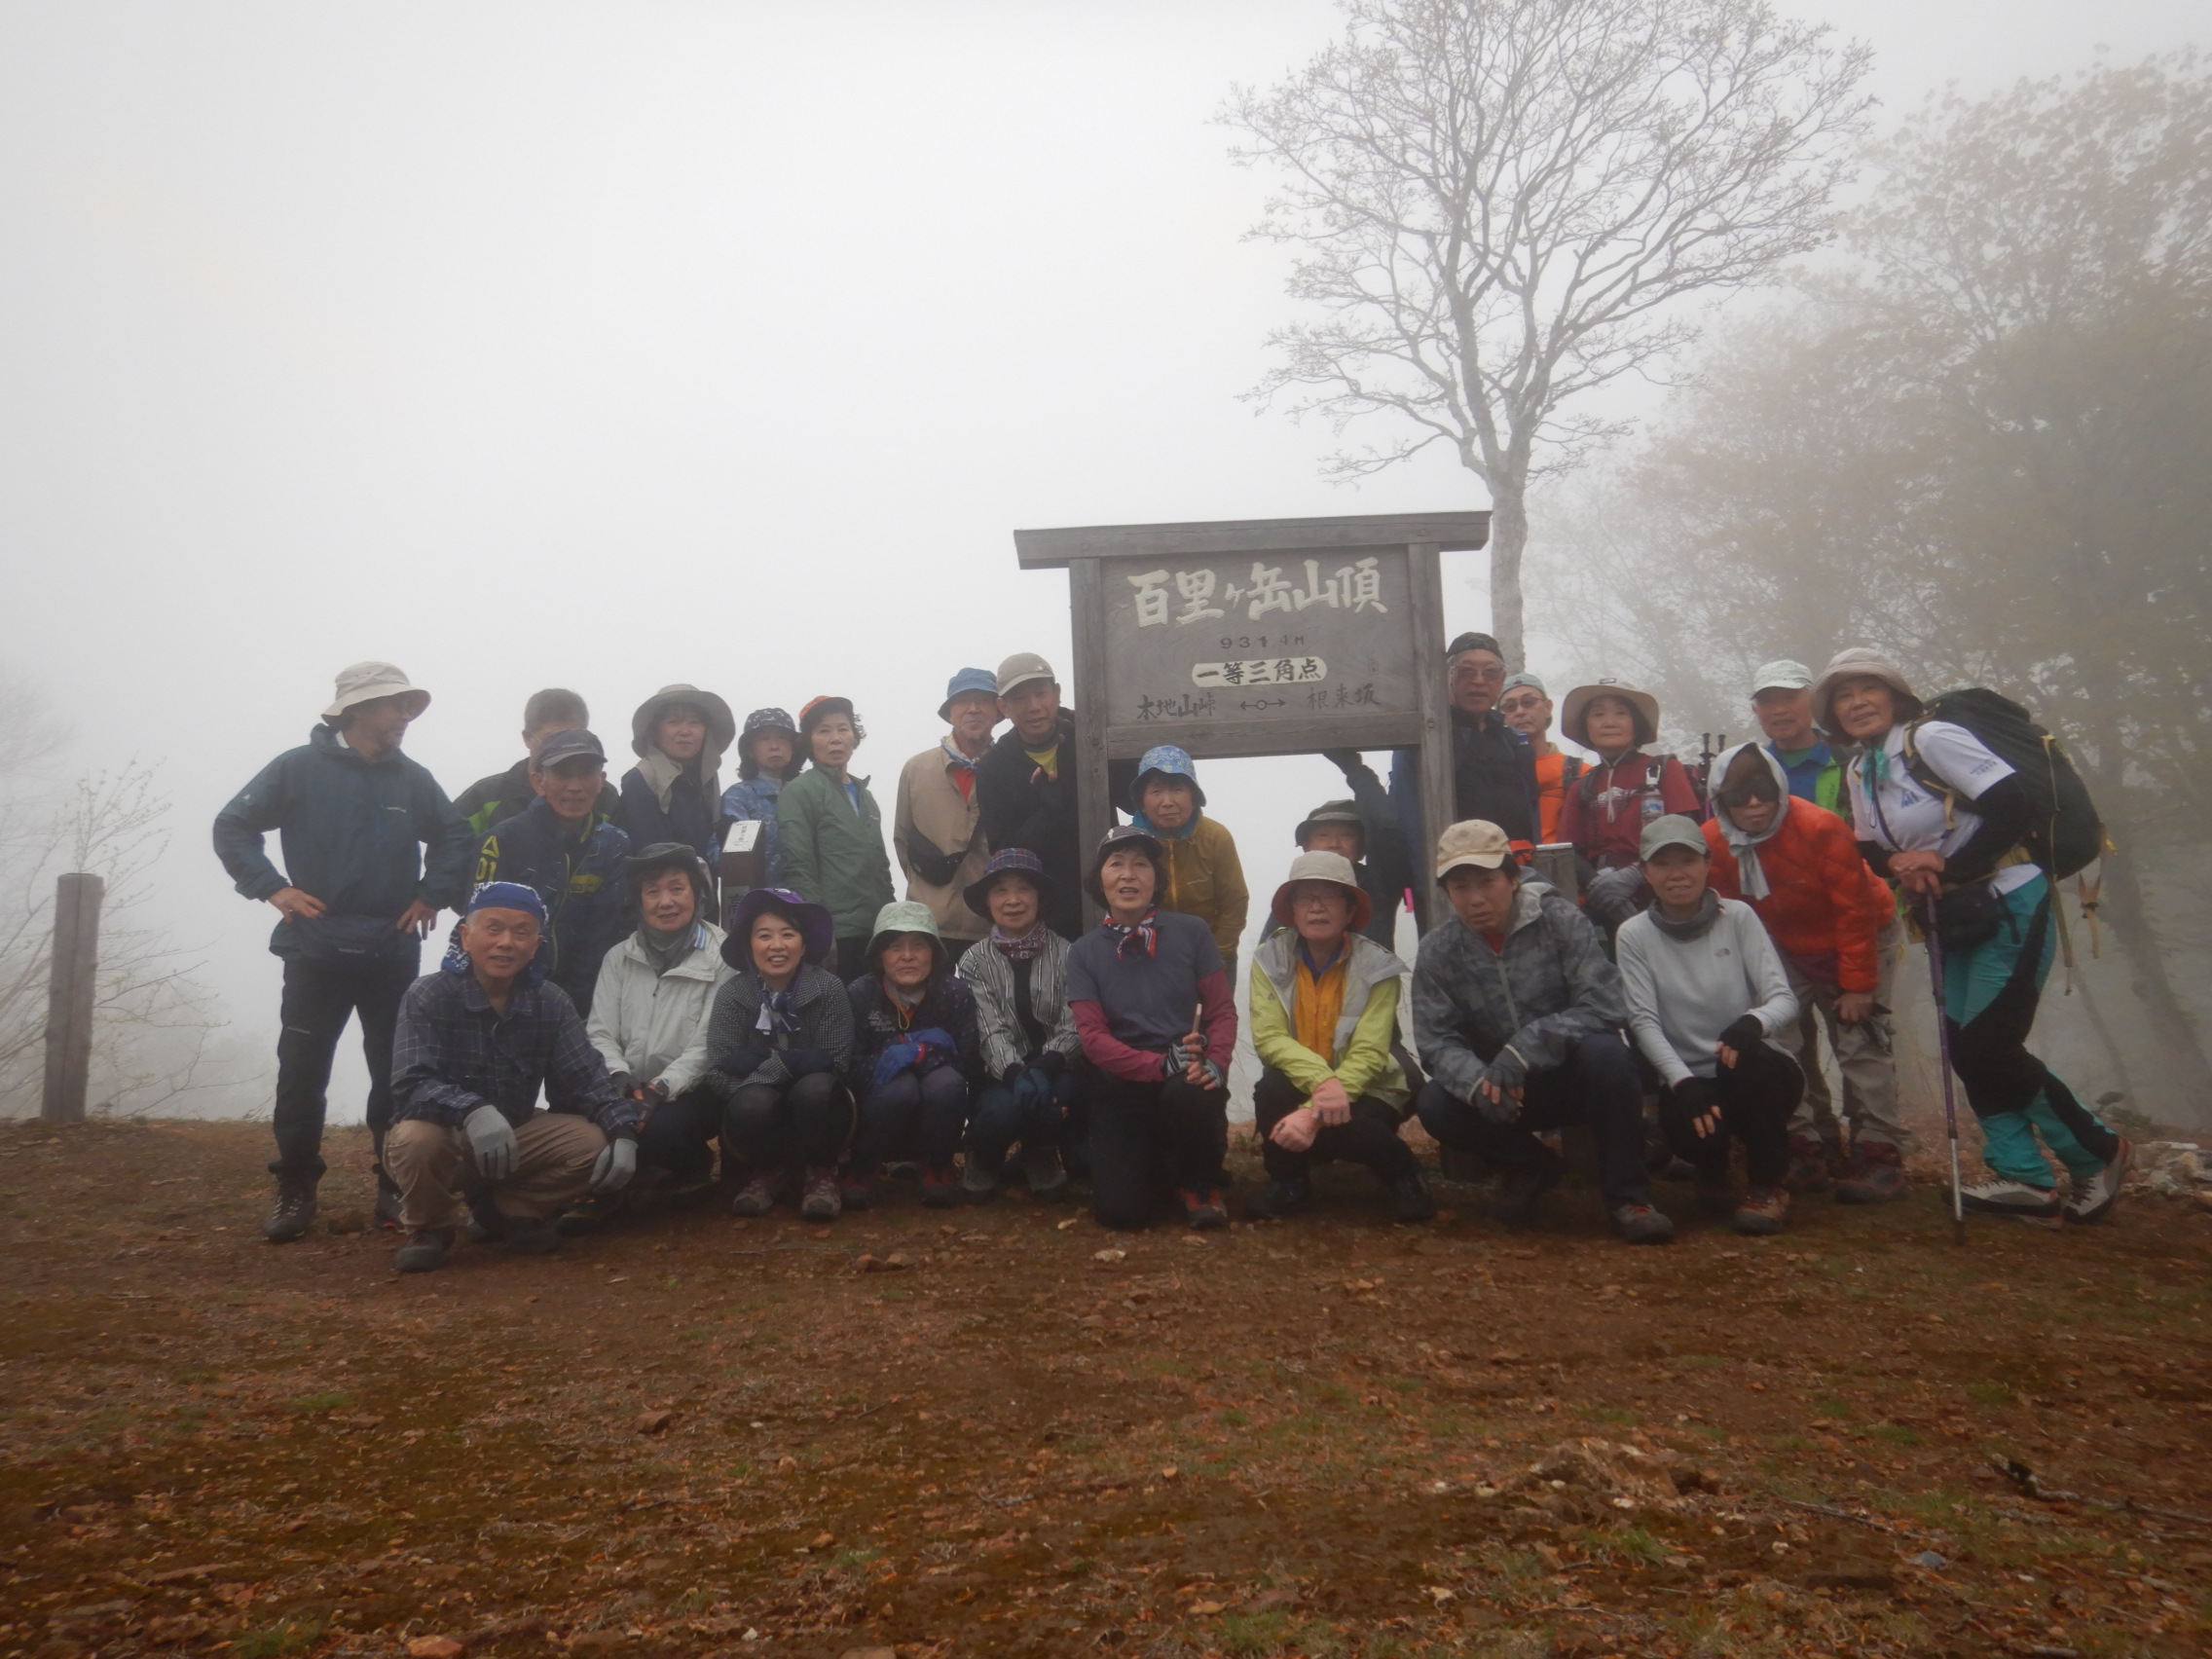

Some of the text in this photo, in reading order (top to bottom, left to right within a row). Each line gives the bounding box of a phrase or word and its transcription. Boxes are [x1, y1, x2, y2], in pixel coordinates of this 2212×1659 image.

[1197, 658, 1321, 685] 一等三角点
[1136, 692, 1216, 720] 木地山峠
